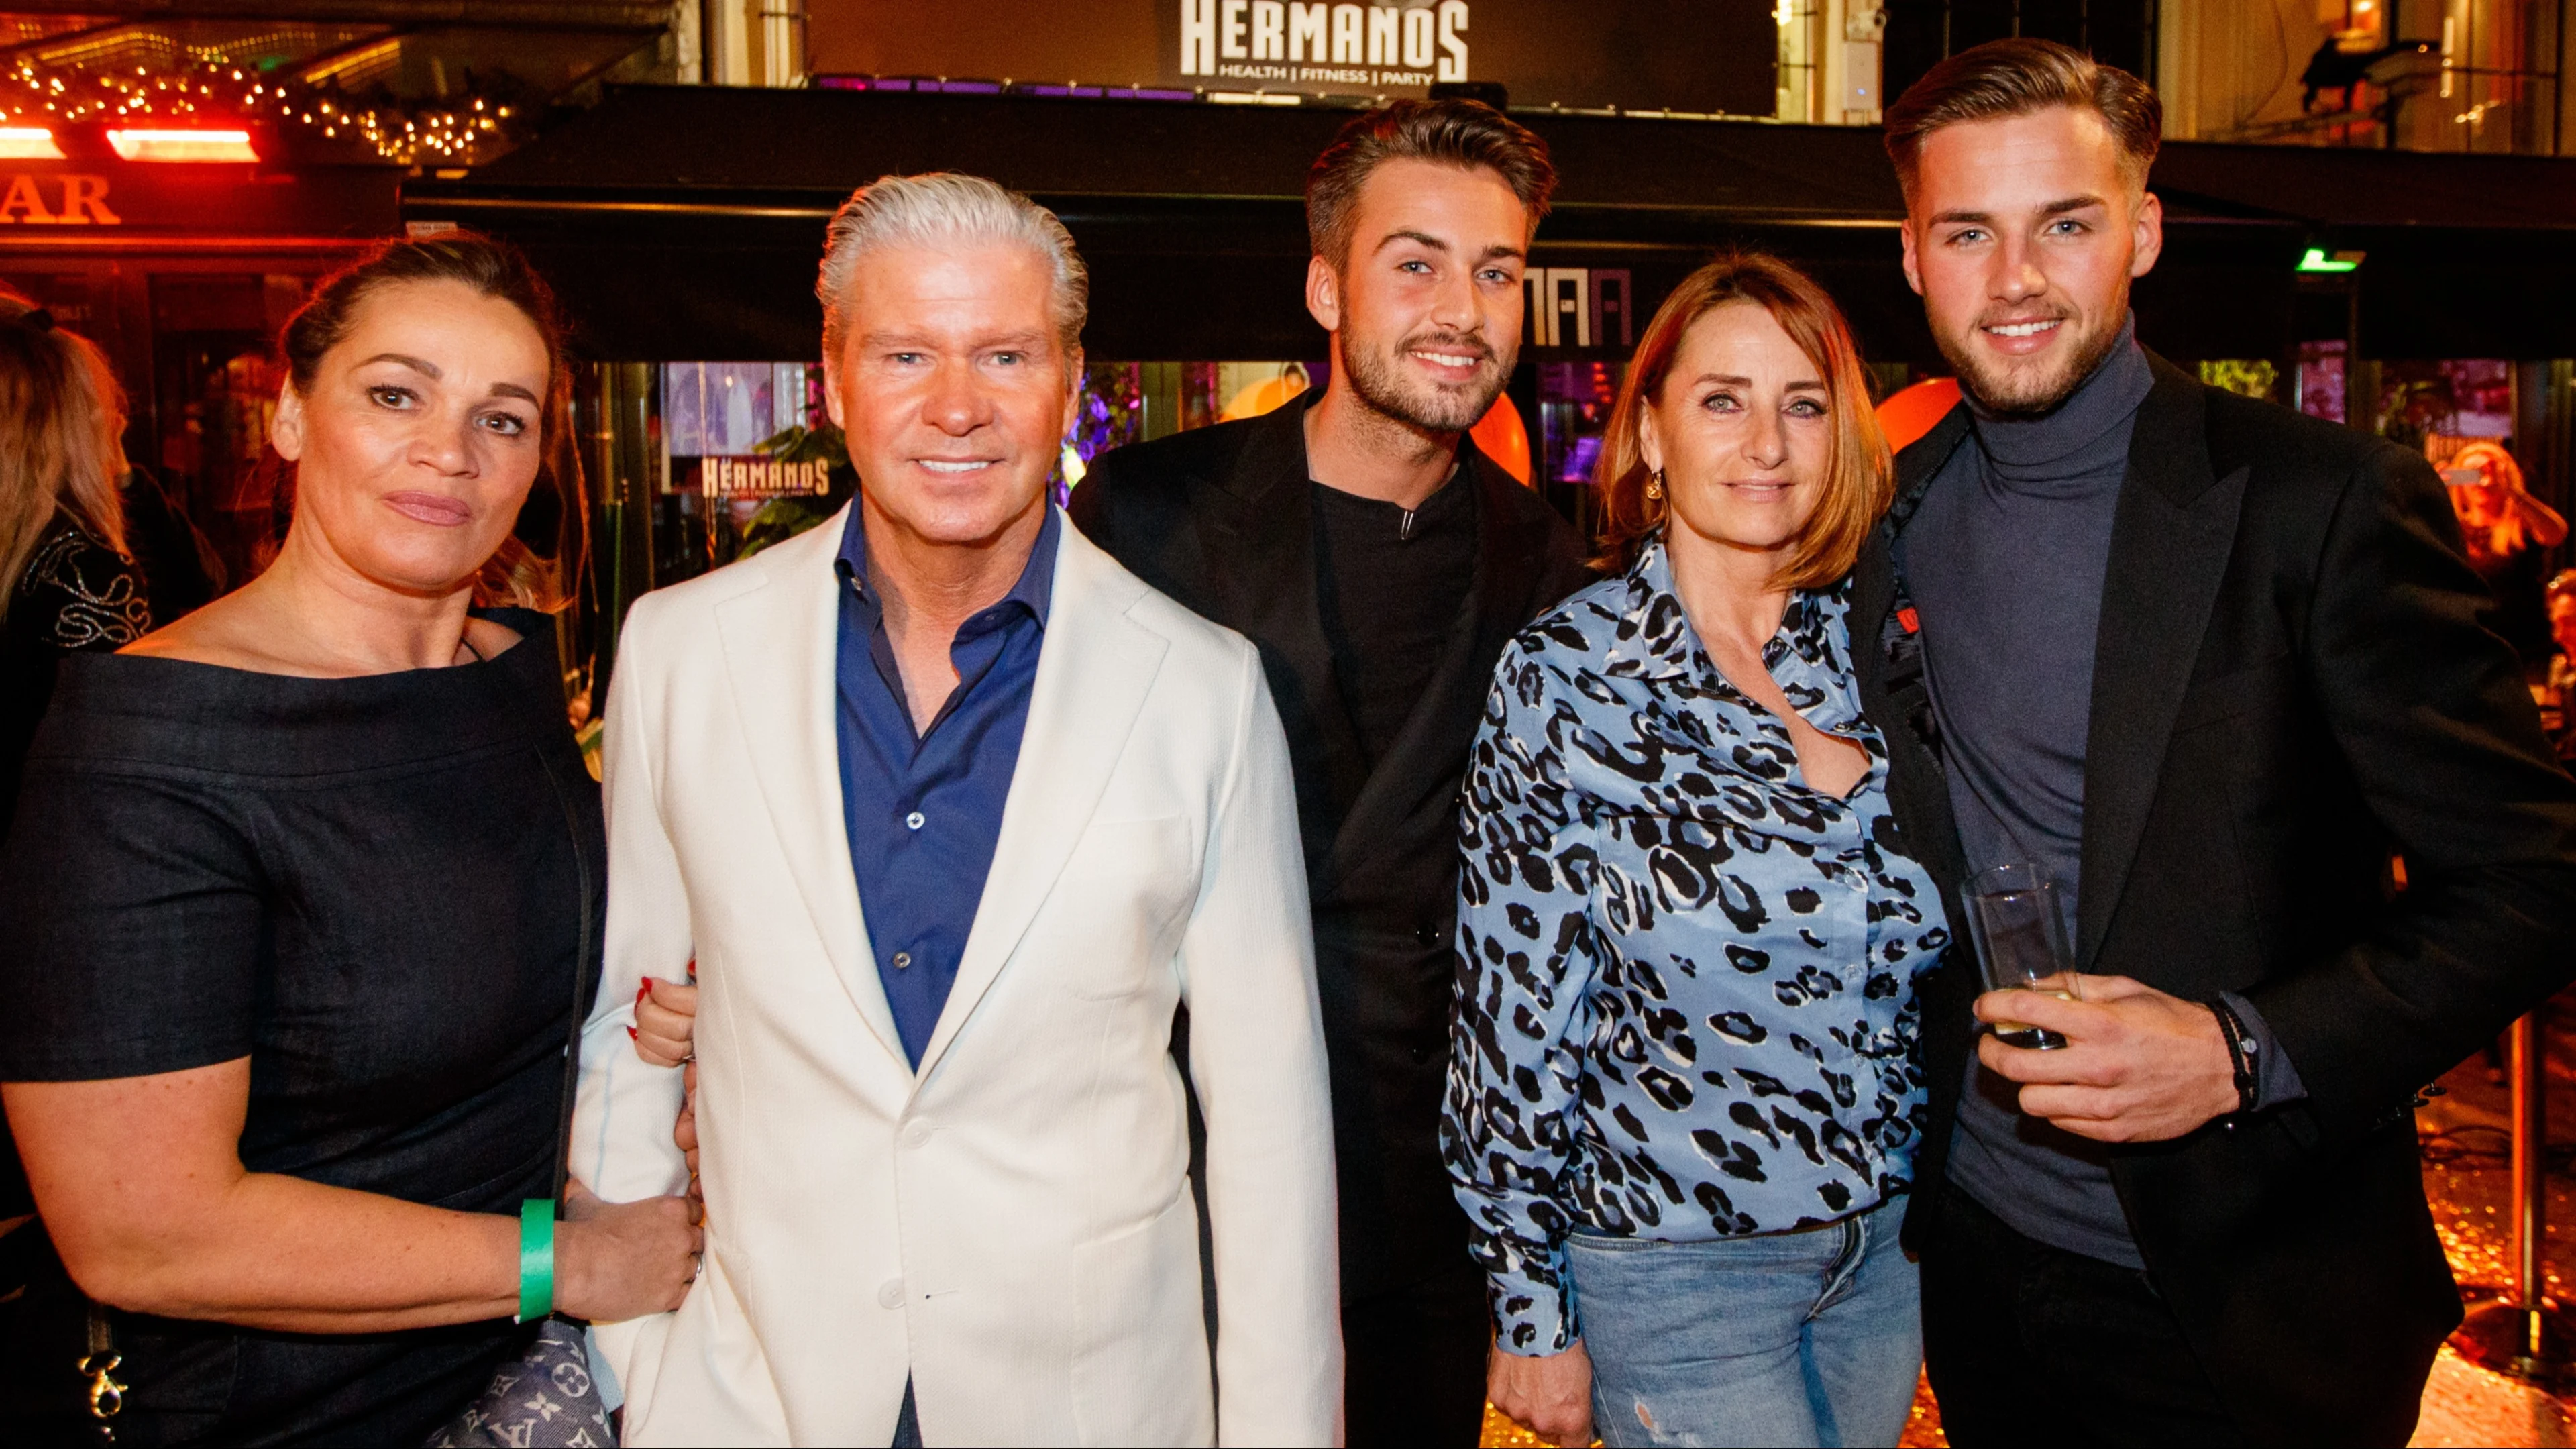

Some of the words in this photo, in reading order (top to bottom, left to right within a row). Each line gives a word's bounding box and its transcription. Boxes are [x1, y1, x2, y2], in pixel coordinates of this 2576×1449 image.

[1181, 0, 1468, 83] HERMANOS
[1219, 64, 1287, 79] HEALTH
[1300, 68, 1368, 84] FITNESS
[1381, 71, 1434, 87] PARTY
[702, 457, 829, 497] HERMANOS
